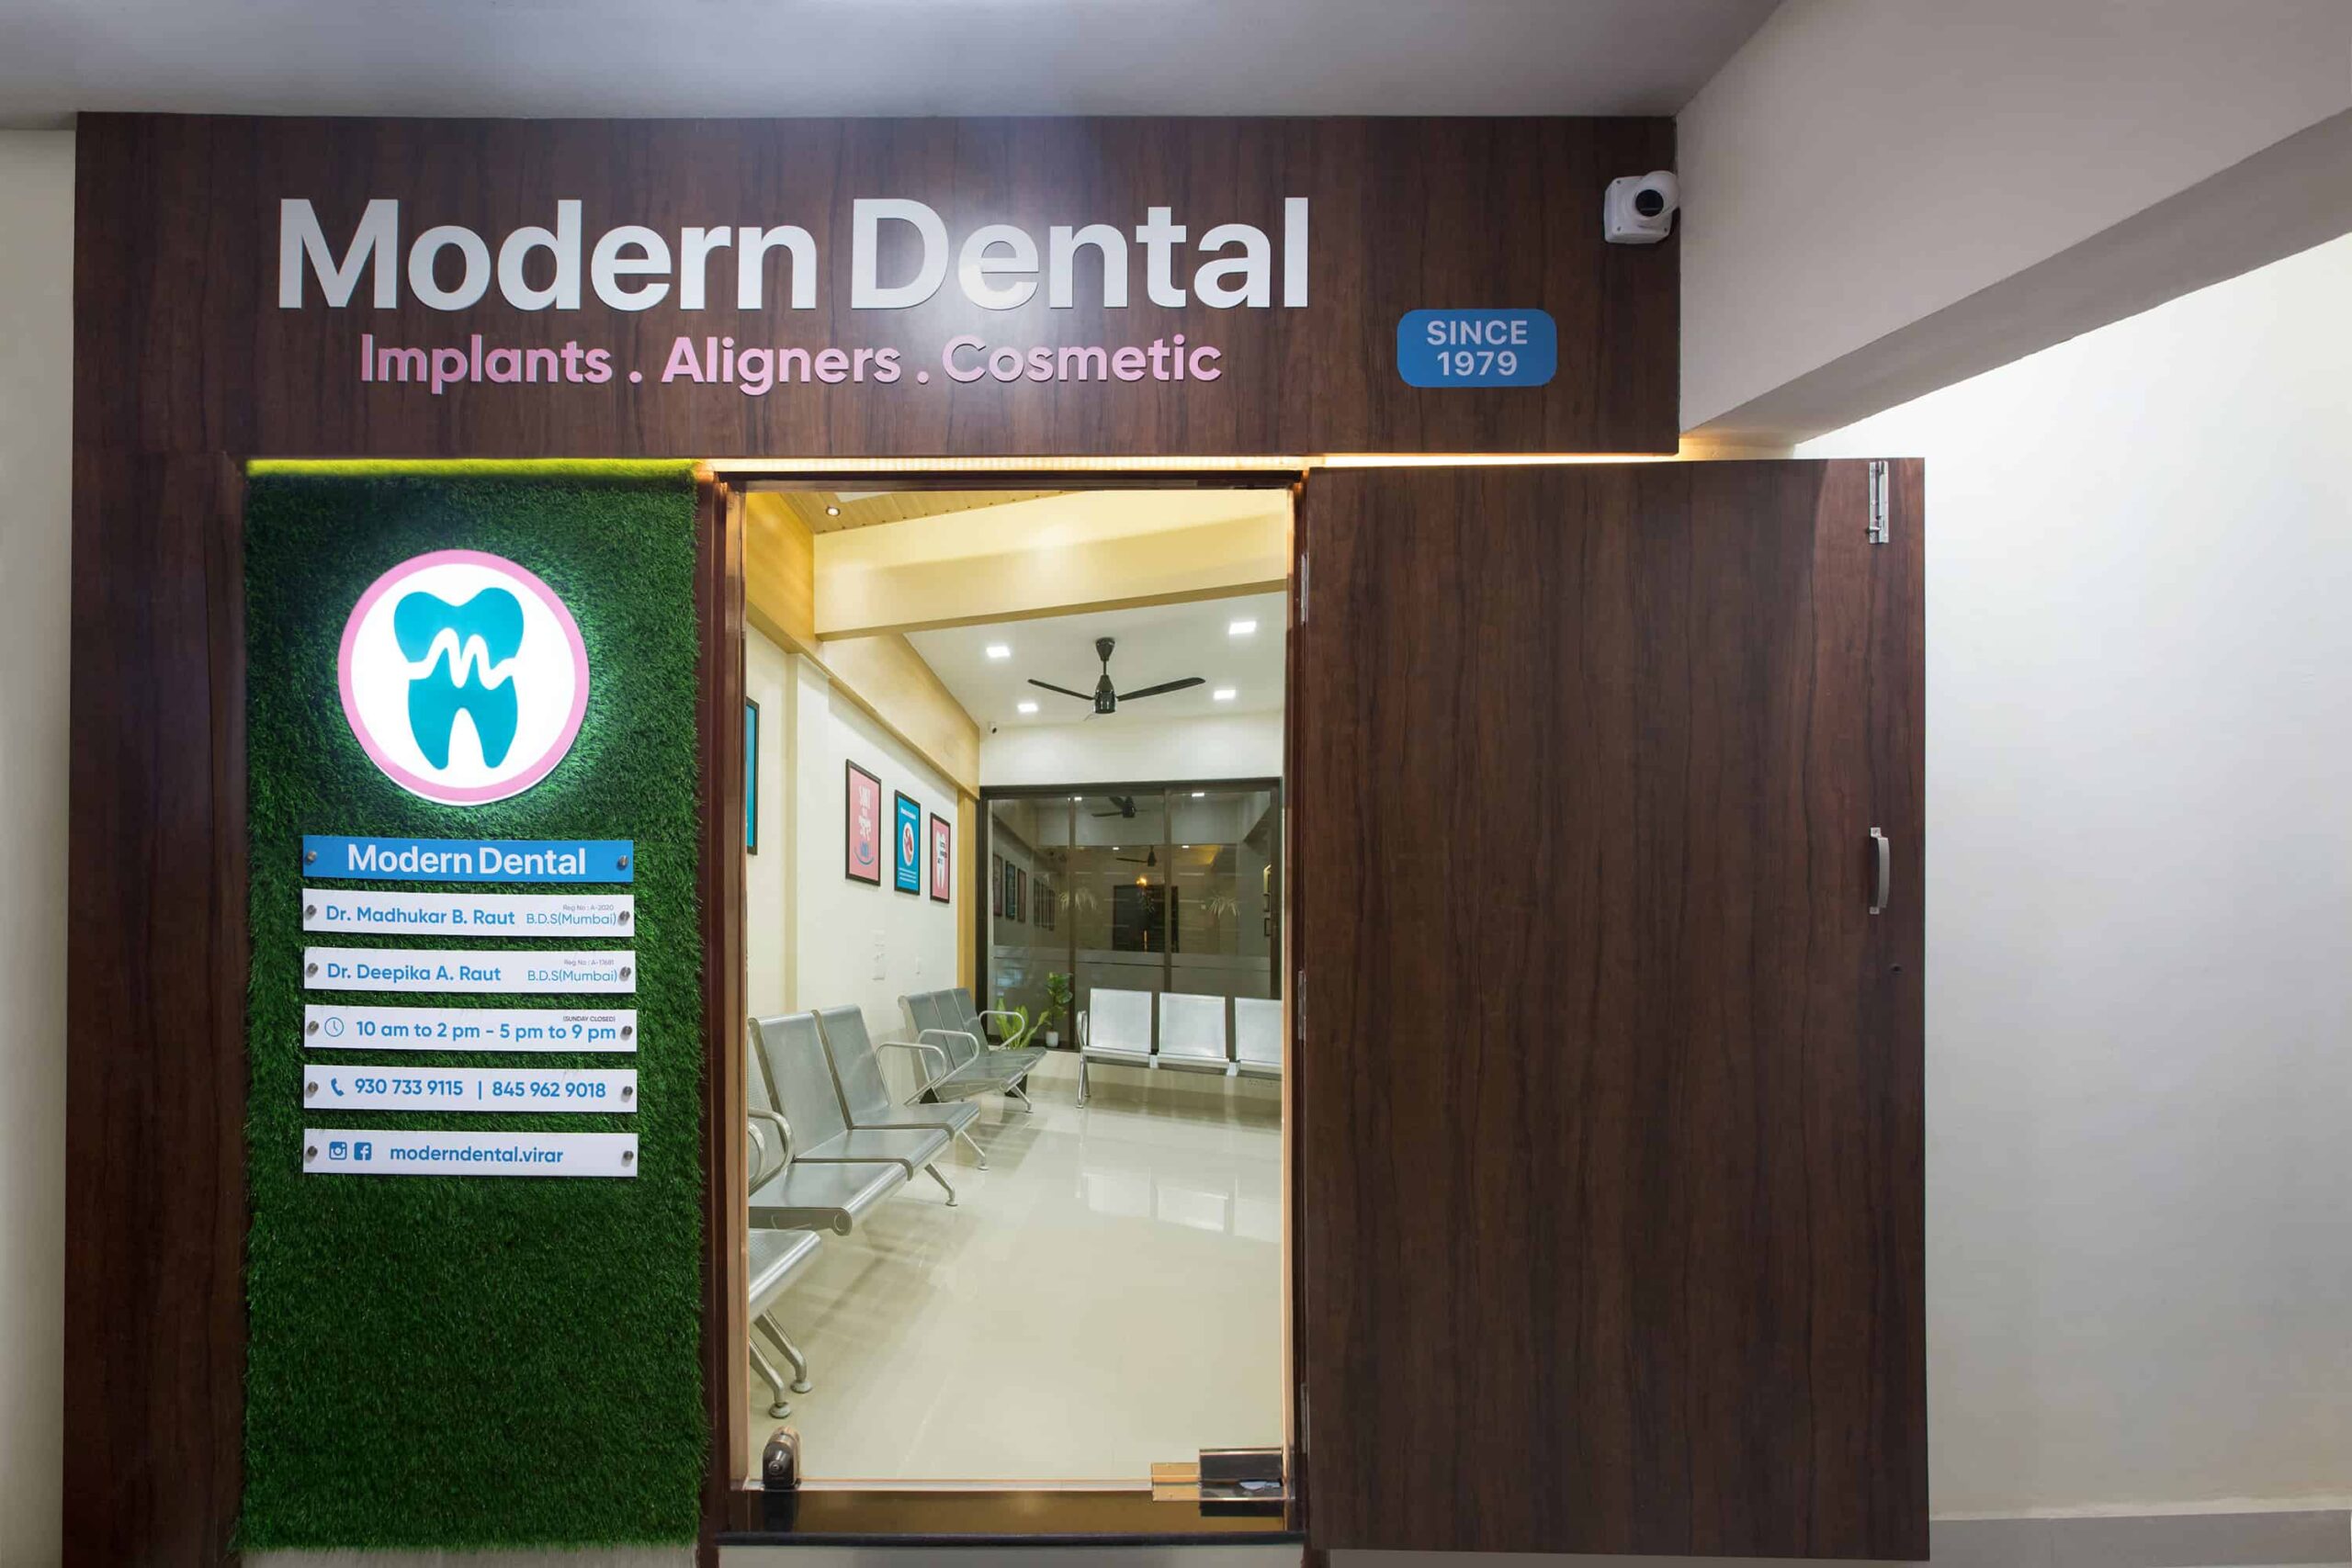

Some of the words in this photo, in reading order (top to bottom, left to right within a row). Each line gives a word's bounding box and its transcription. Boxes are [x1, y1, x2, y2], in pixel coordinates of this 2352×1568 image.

[278, 197, 818, 311] Modern
[851, 197, 1309, 310] Dental
[1426, 320, 1528, 345] SINCE
[361, 333, 613, 395] Implants
[662, 336, 901, 396] Aligners
[942, 333, 1223, 383] Cosmetic
[1437, 351, 1518, 377] 1979
[347, 843, 472, 874] Modern
[479, 847, 586, 875] Dental
[326, 905, 351, 921] Dr.
[356, 907, 447, 924] Madhukar
[452, 909, 468, 925] B.
[473, 909, 515, 926] Raut
[526, 912, 617, 927] B.D.S(Mumbai)
[327, 963, 352, 979] Dr.
[356, 964, 431, 984] Deepika
[435, 965, 454, 981] A.
[458, 966, 501, 982] Raut
[527, 969, 618, 984] B.D.S(Mumbai)
[356, 1021, 377, 1036] 10
[381, 1025, 410, 1037] am
[413, 1022, 432, 1037] to
[436, 1022, 447, 1038] 2
[452, 1025, 481, 1042] pm
[499, 1023, 510, 1039] 5
[515, 1027, 544, 1043] pm
[548, 1023, 567, 1040] to
[571, 1024, 583, 1039] 9
[588, 1028, 616, 1043] pm
[355, 1078, 388, 1095] 930
[392, 1078, 423, 1096] 733
[427, 1079, 464, 1097] 9115
[492, 1080, 526, 1098] 845
[530, 1081, 560, 1099] 962
[565, 1081, 606, 1099] 9018
[390, 1145, 563, 1164] moderndental.virar
